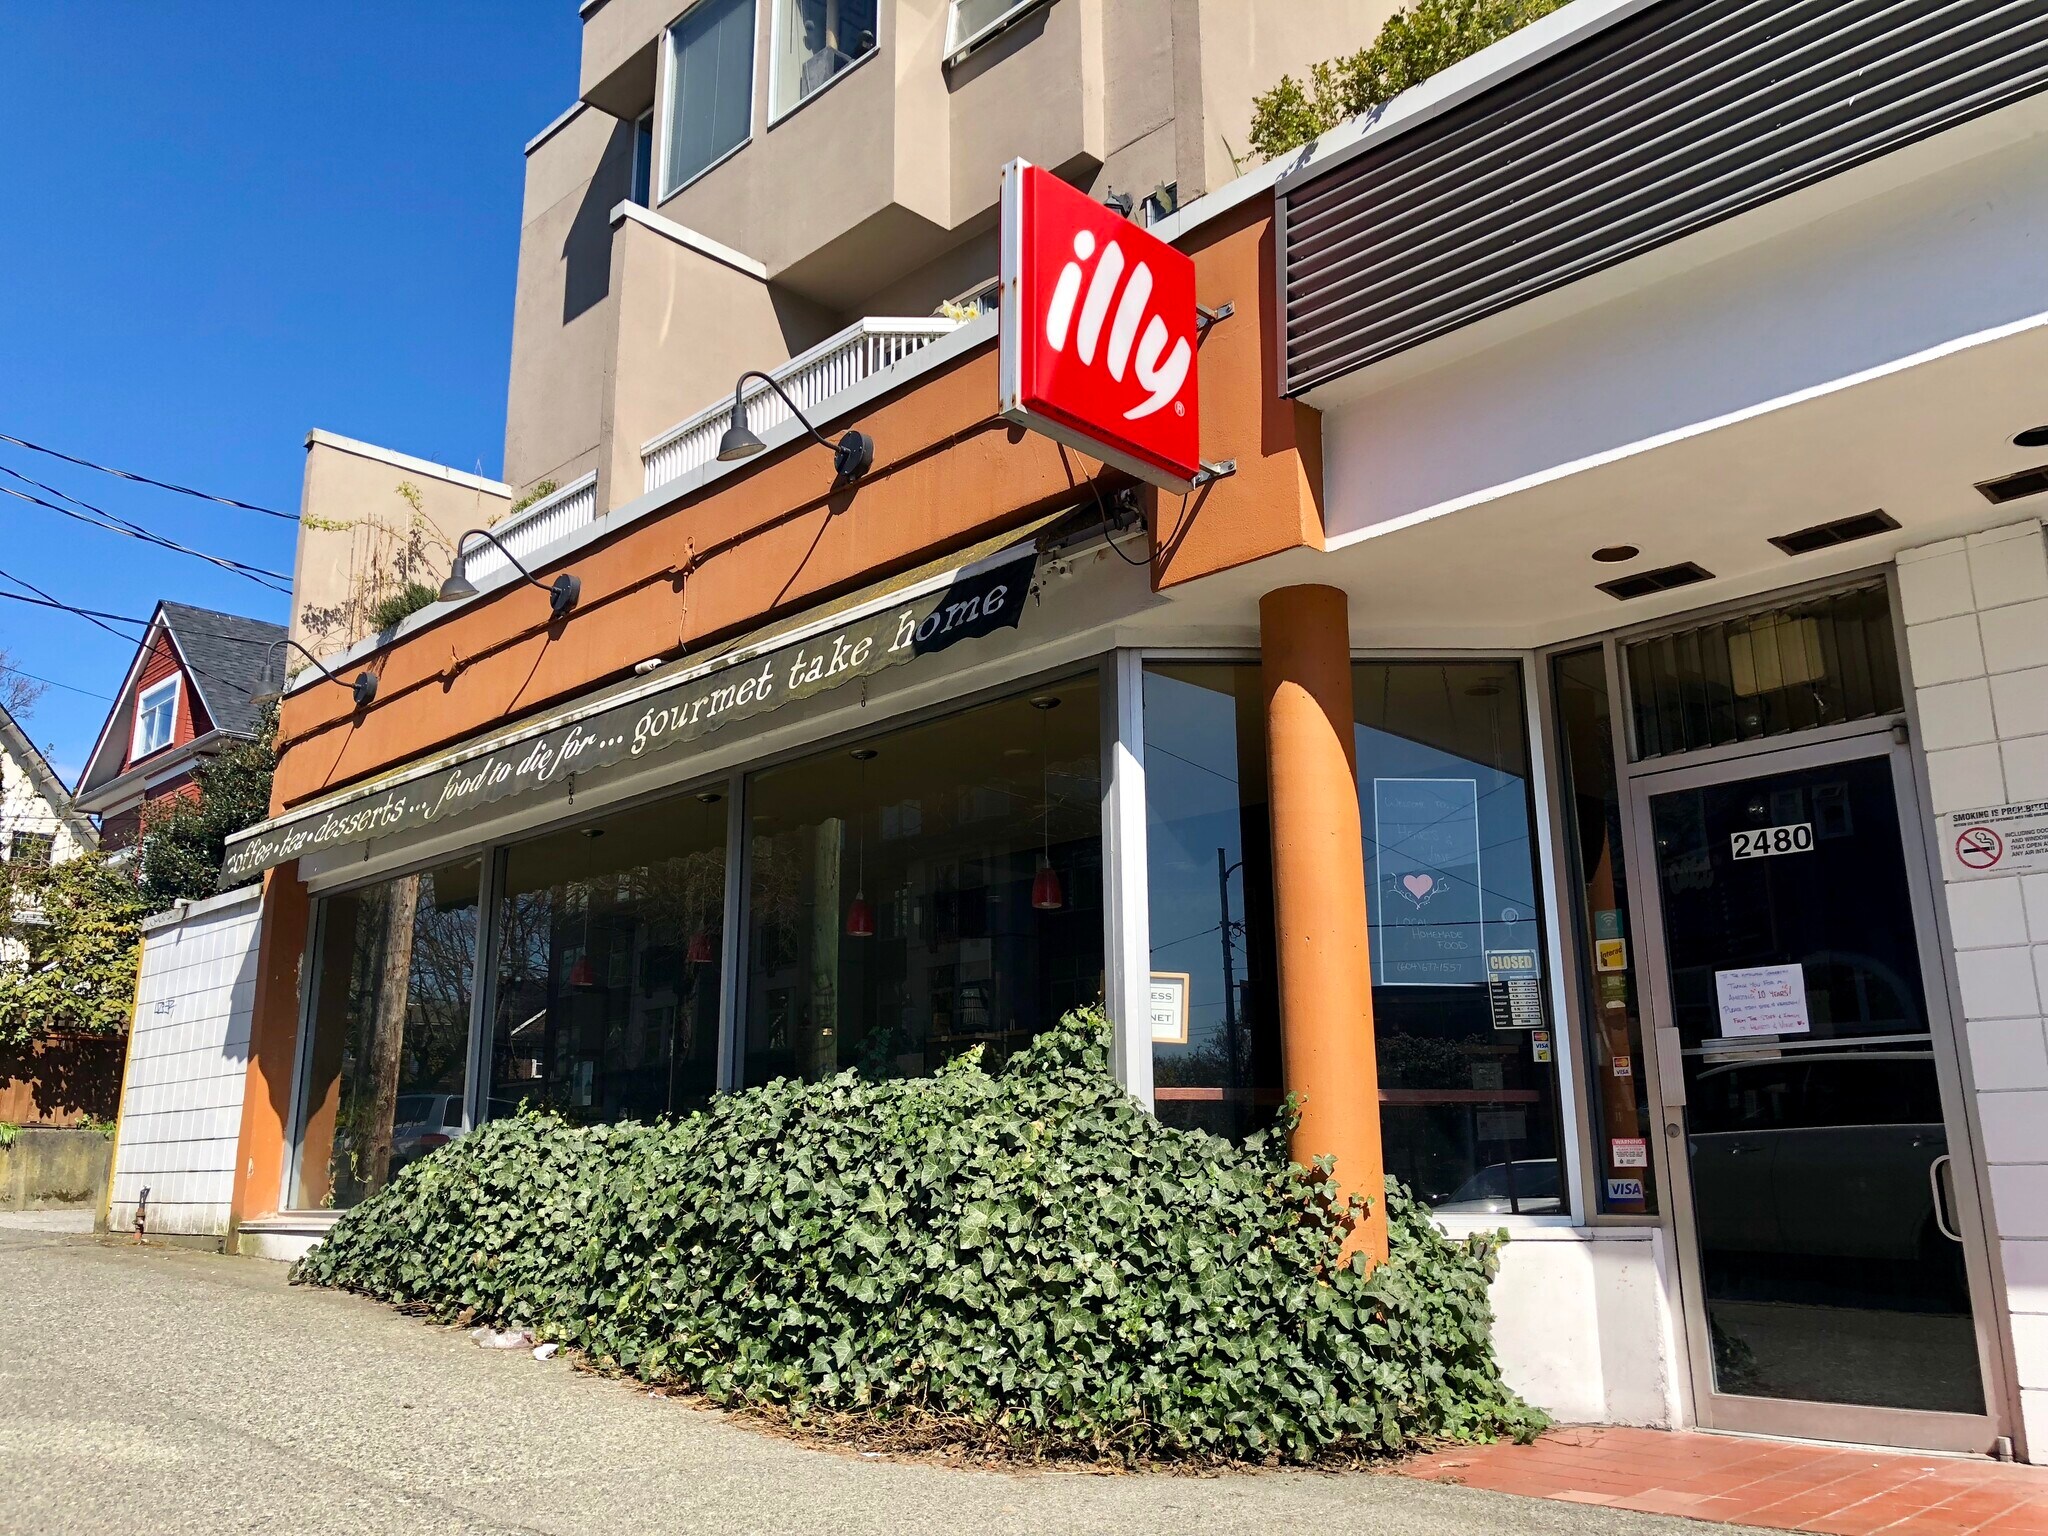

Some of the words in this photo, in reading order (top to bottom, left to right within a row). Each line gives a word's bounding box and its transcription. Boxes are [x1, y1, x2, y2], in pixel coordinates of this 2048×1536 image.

[1046, 230, 1191, 420] illy
[424, 758, 494, 819] food
[487, 761, 514, 786] to
[516, 740, 553, 776] die
[631, 661, 774, 755] gourmet
[788, 634, 873, 691] take
[888, 584, 1008, 652] home
[1953, 810, 1989, 822] SMOKING
[1991, 809, 1999, 817] IS
[1733, 826, 1811, 858] 2480
[1437, 941, 1468, 950] FOOD
[1490, 955, 1533, 970] CLOSED
[1757, 990, 1766, 999] 10
[1611, 1183, 1641, 1195] VISA
